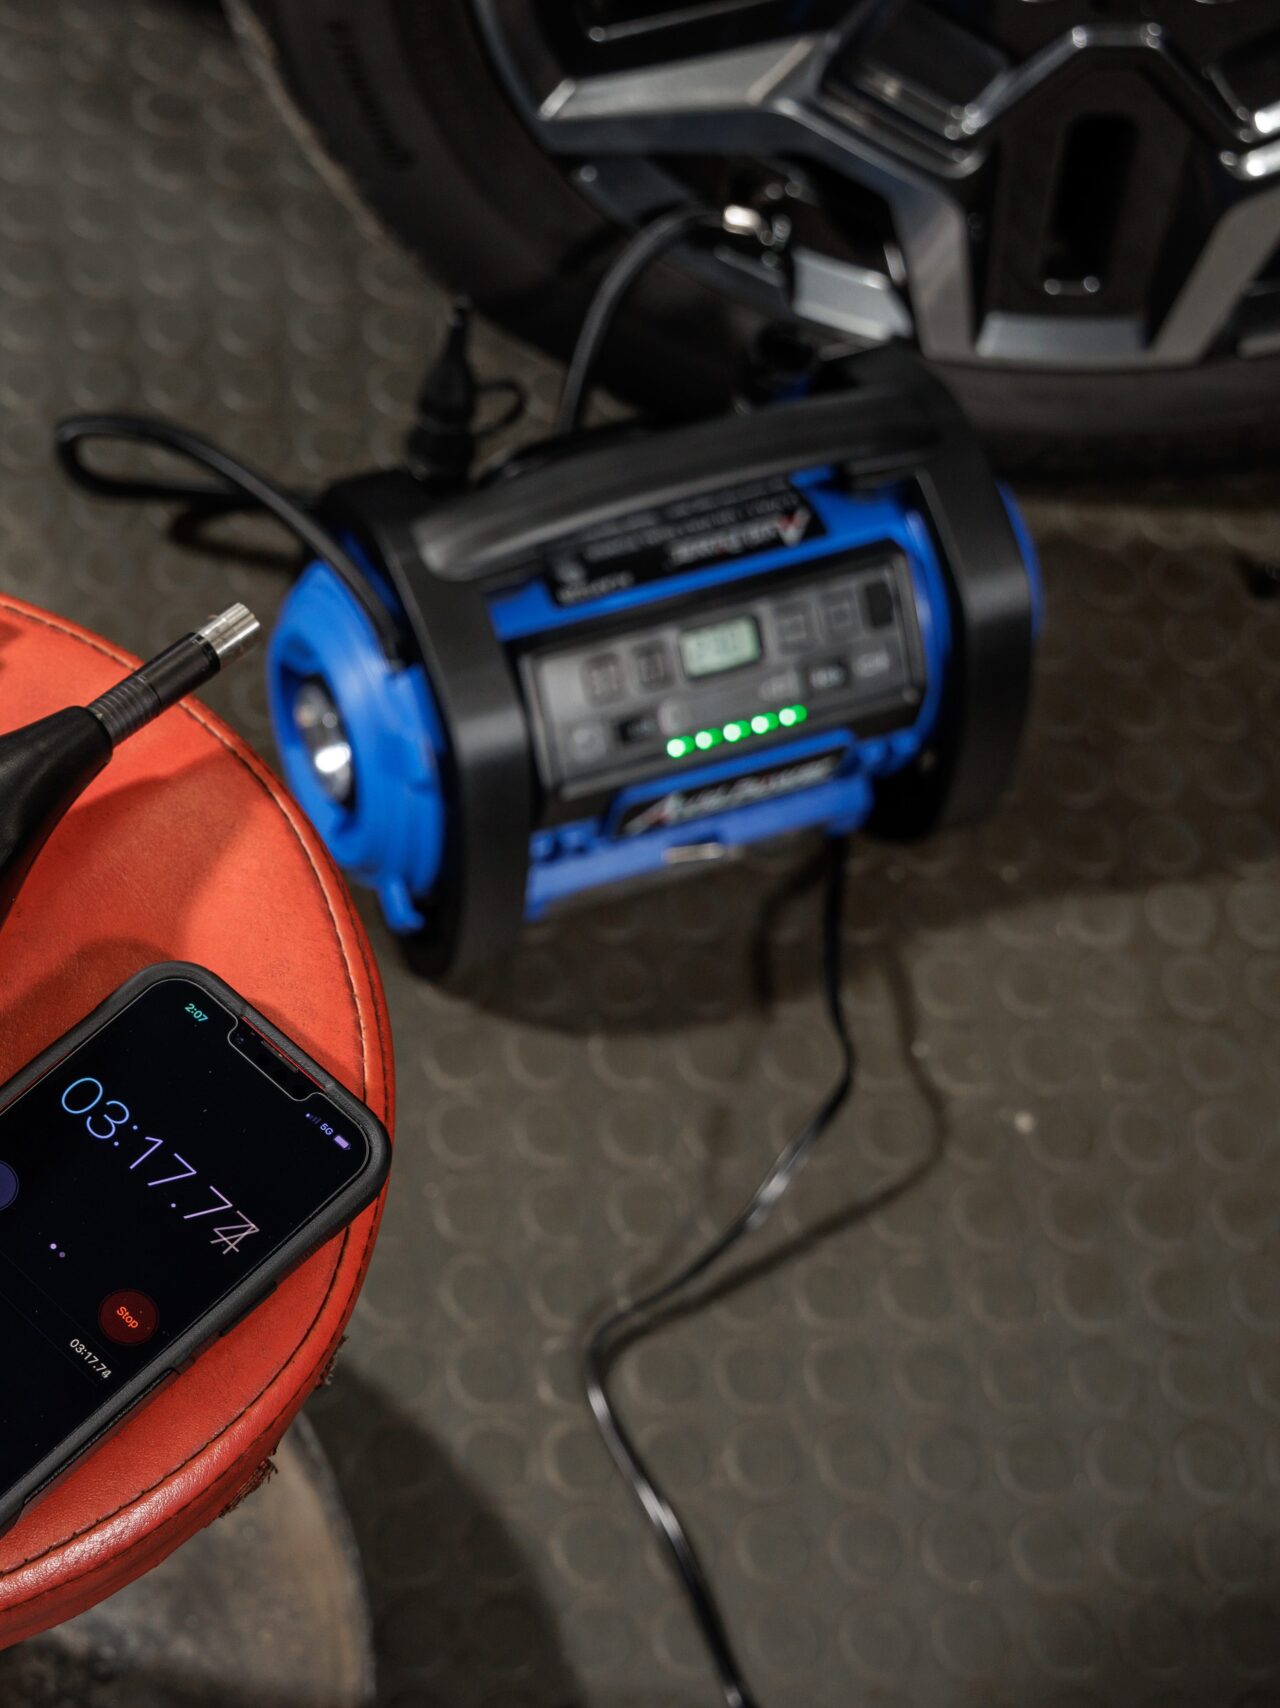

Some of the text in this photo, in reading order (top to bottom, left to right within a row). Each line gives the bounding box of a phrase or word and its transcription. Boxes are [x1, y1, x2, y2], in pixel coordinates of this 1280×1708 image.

[184, 1003, 209, 1023] 2:07
[320, 1123, 334, 1136] 5G
[116, 1306, 139, 1330] Stop
